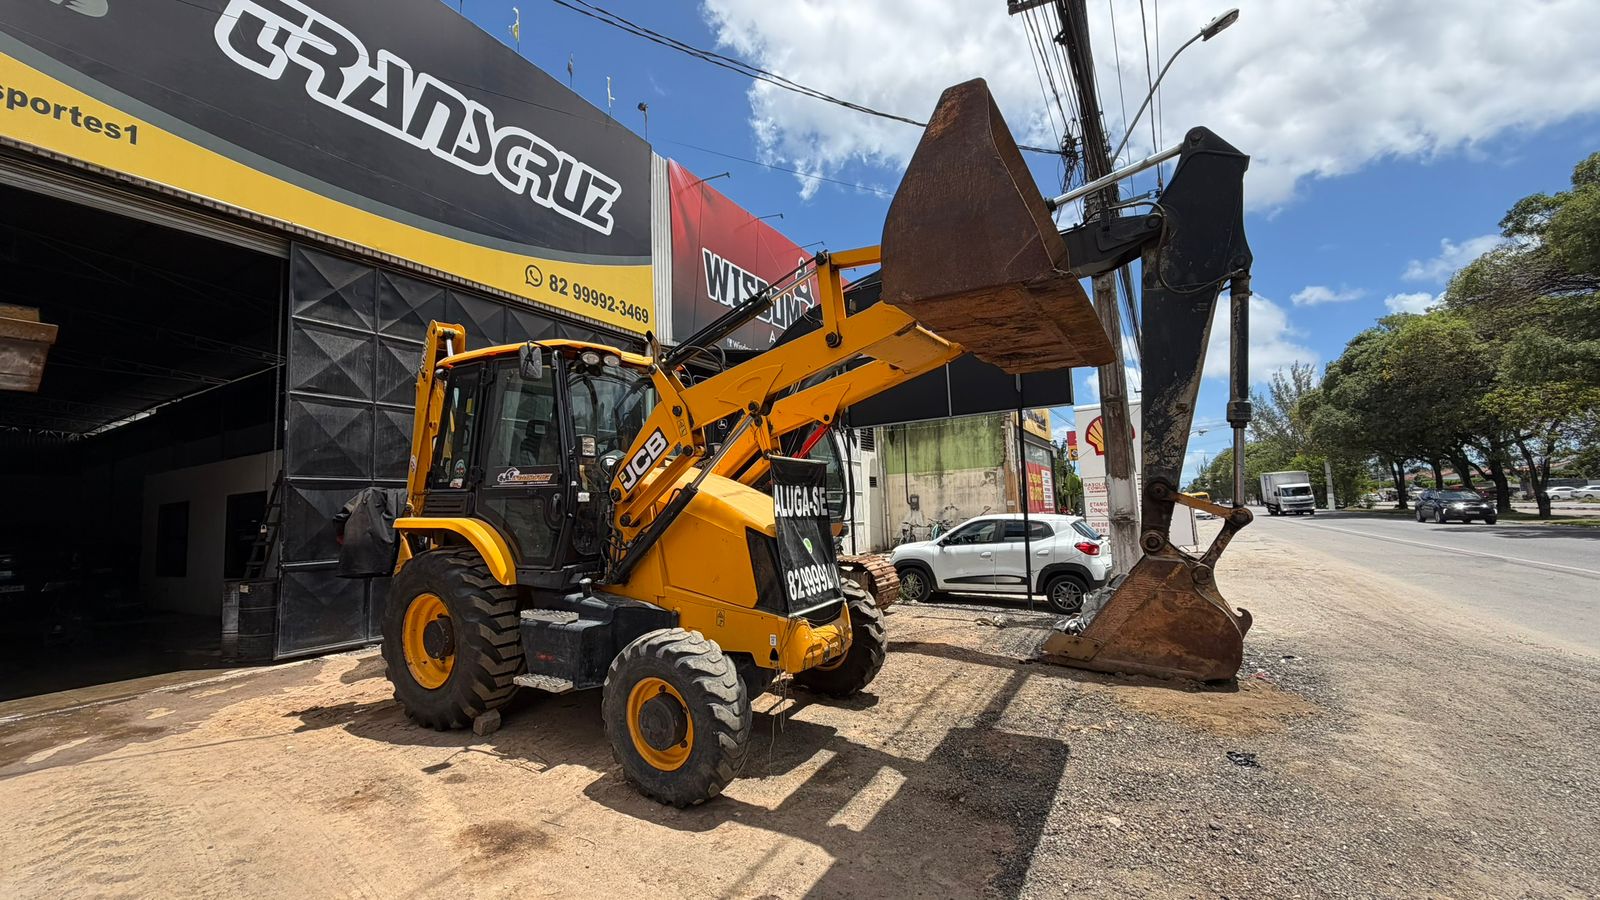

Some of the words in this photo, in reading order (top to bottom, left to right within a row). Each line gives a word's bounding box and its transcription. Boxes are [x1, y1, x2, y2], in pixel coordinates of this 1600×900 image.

[0, 85, 138, 145] portes1
[549, 274, 569, 297] 82
[572, 282, 649, 324] 99992-3469
[622, 430, 667, 490] JCB
[774, 484, 828, 518] ALUGA-SE
